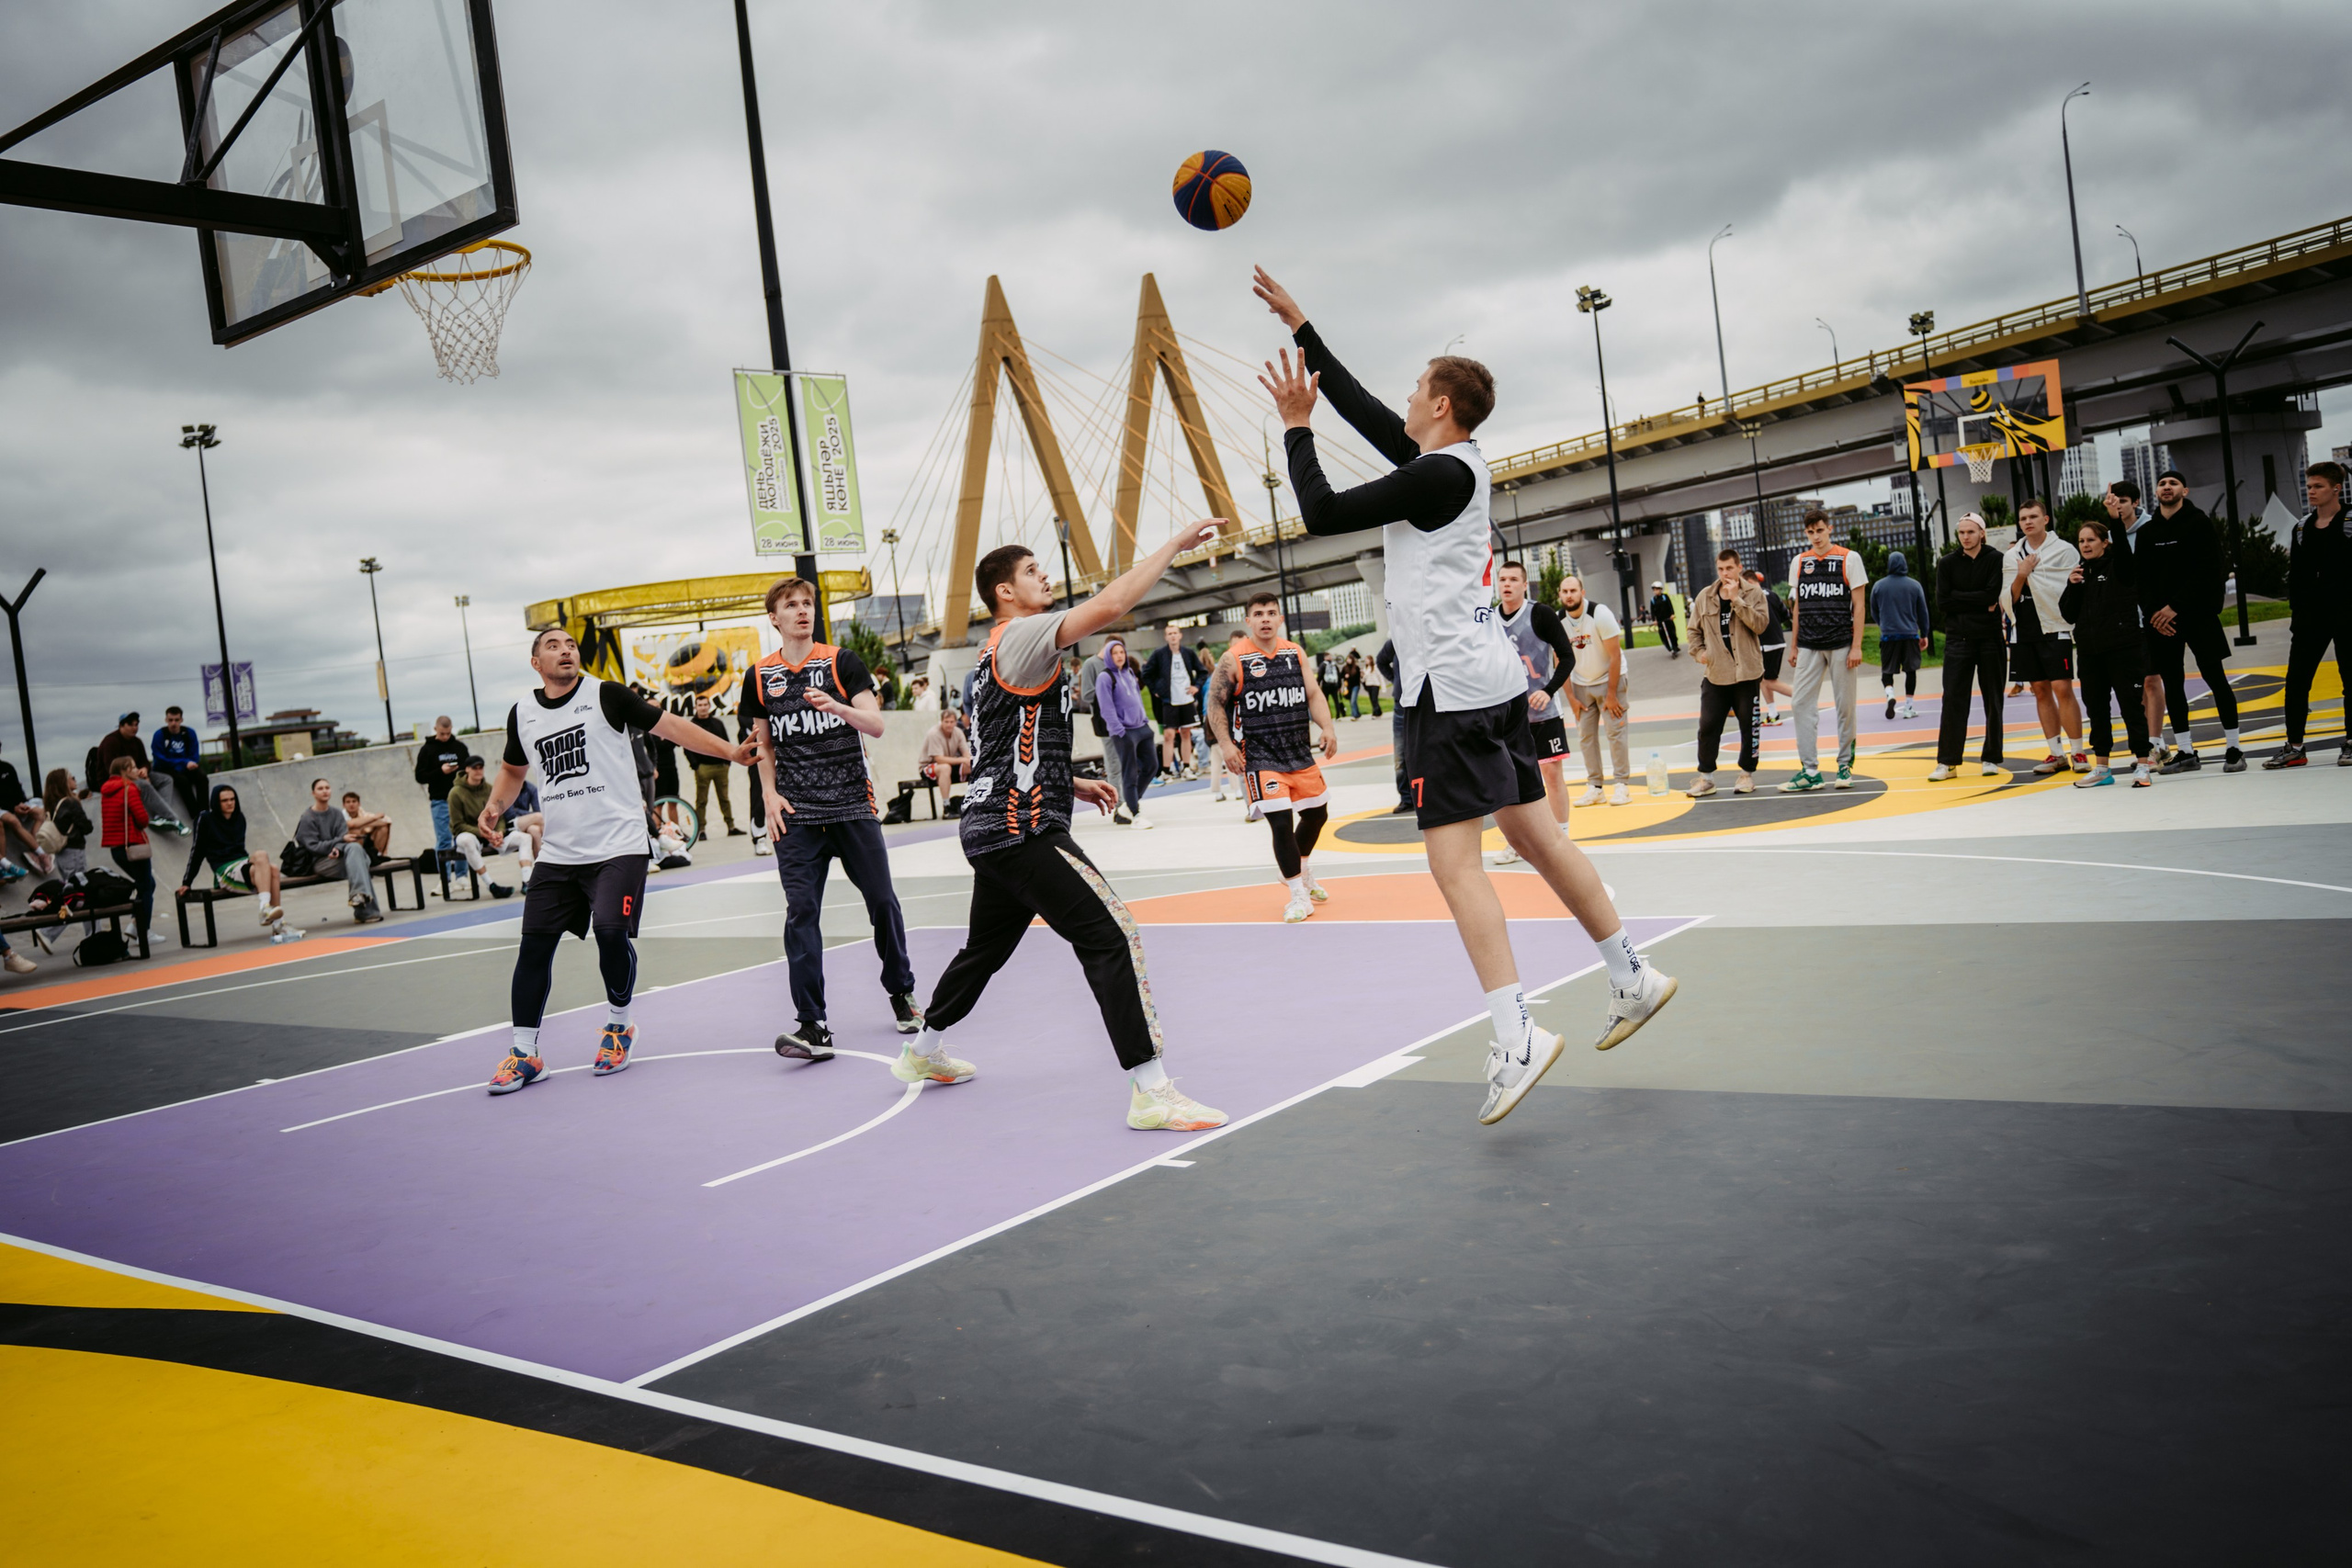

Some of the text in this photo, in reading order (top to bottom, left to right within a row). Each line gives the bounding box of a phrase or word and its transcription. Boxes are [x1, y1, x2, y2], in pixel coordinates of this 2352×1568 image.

[768, 418, 783, 451] 2025
[760, 423, 778, 510] МОЛОДЁЖИ
[827, 417, 848, 511] КӨНЕ 2025
[820, 440, 837, 511] ЯШЬЛӘР
[756, 471, 769, 510] ДЕНЬ
[761, 538, 799, 548] 28 июня
[823, 536, 835, 547] 28
[1827, 560, 1837, 572] 11
[1799, 581, 1844, 599] БУКИНЫ
[1285, 656, 1293, 671] 1
[2064, 658, 2069, 671] 1
[808, 670, 824, 687] 10
[1245, 686, 1306, 712] БУКИНЫ
[1548, 737, 1564, 753] 12
[567, 789, 584, 798] Био
[586, 784, 605, 795] Тест
[1410, 776, 1425, 808] 7
[622, 895, 633, 917] 6
